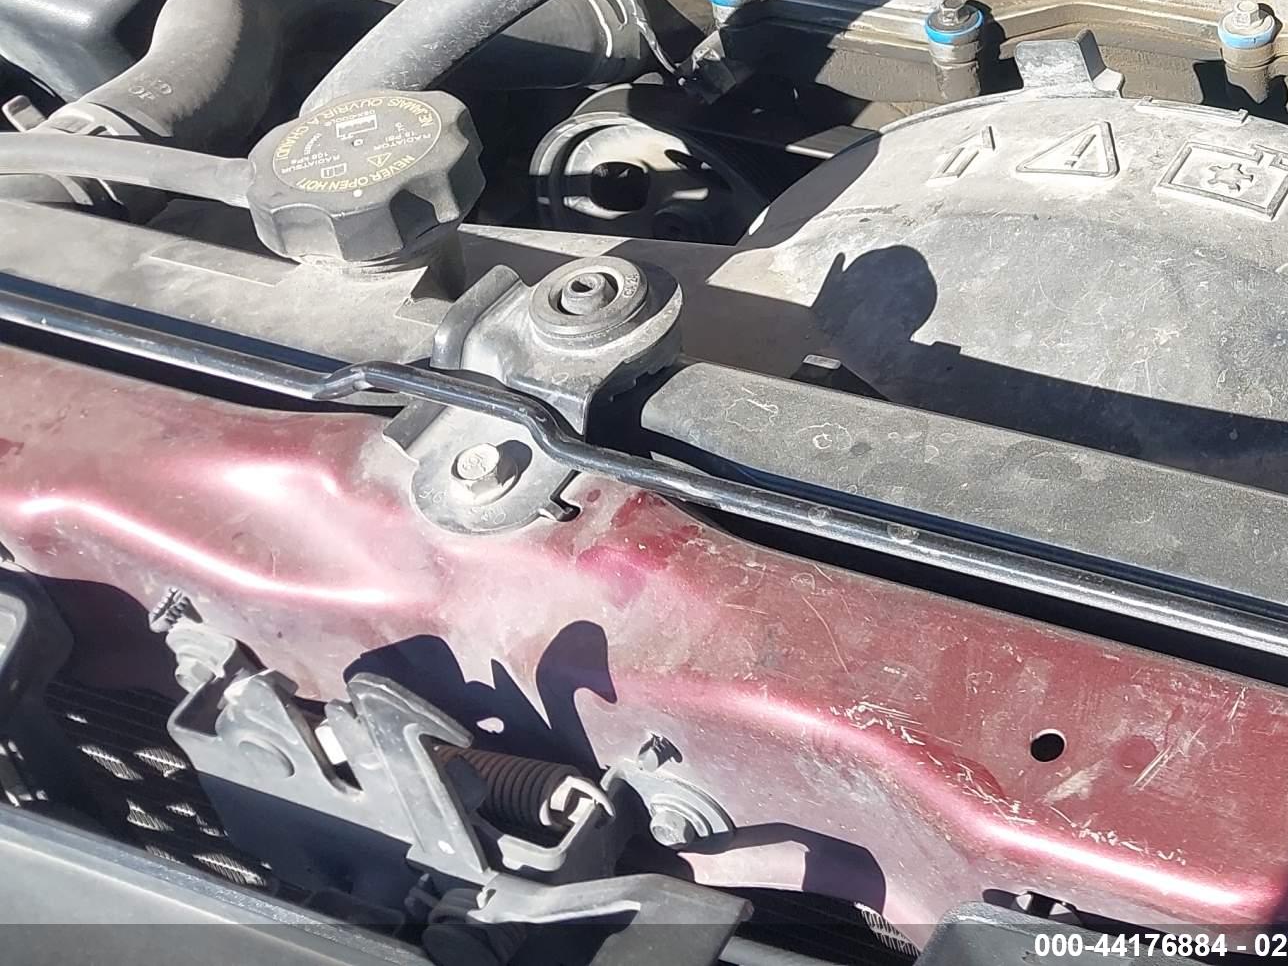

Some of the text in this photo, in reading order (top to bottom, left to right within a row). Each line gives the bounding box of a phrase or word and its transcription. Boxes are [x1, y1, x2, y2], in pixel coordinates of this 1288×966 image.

[321, 98, 384, 120] OUVRIR
[373, 133, 432, 151] RADIATOR
[369, 153, 416, 184] NEVER
[327, 175, 370, 192] OPEN
